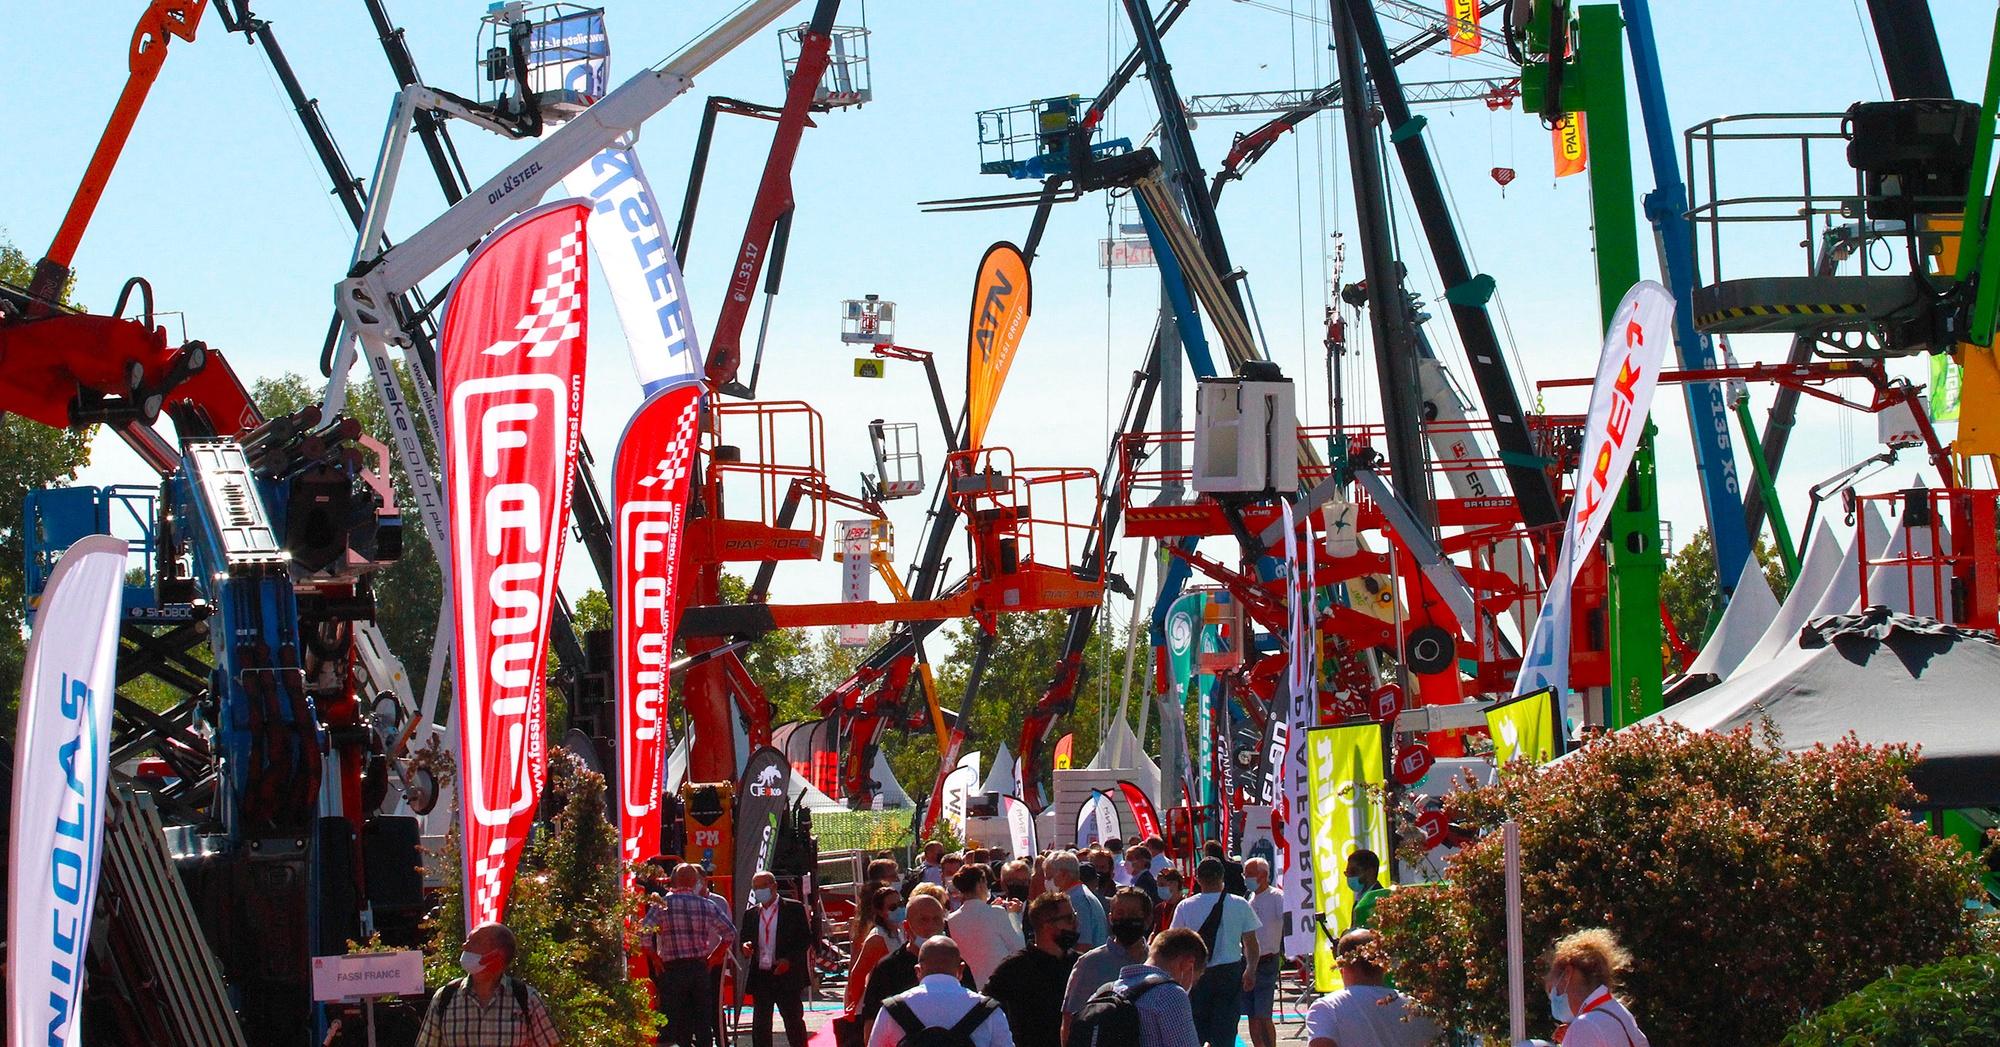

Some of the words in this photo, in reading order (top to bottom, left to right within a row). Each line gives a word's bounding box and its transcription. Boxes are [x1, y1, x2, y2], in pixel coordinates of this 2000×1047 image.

[976, 268, 1012, 364] ATN
[995, 342, 1010, 373] FASSI
[1008, 305, 1024, 341] GROUP
[375, 357, 407, 431] snake
[403, 437, 428, 488] 2010
[422, 493, 434, 507] H
[430, 512, 445, 541] plus
[565, 374, 580, 508] www.fassi.com
[1721, 458, 1738, 494] XC
[665, 503, 682, 597] www.fassi.com
[47, 672, 88, 1047] NICOLAS
[695, 830, 720, 847] PM
[337, 972, 362, 982] FASSI
[364, 969, 401, 980] FRANCE
